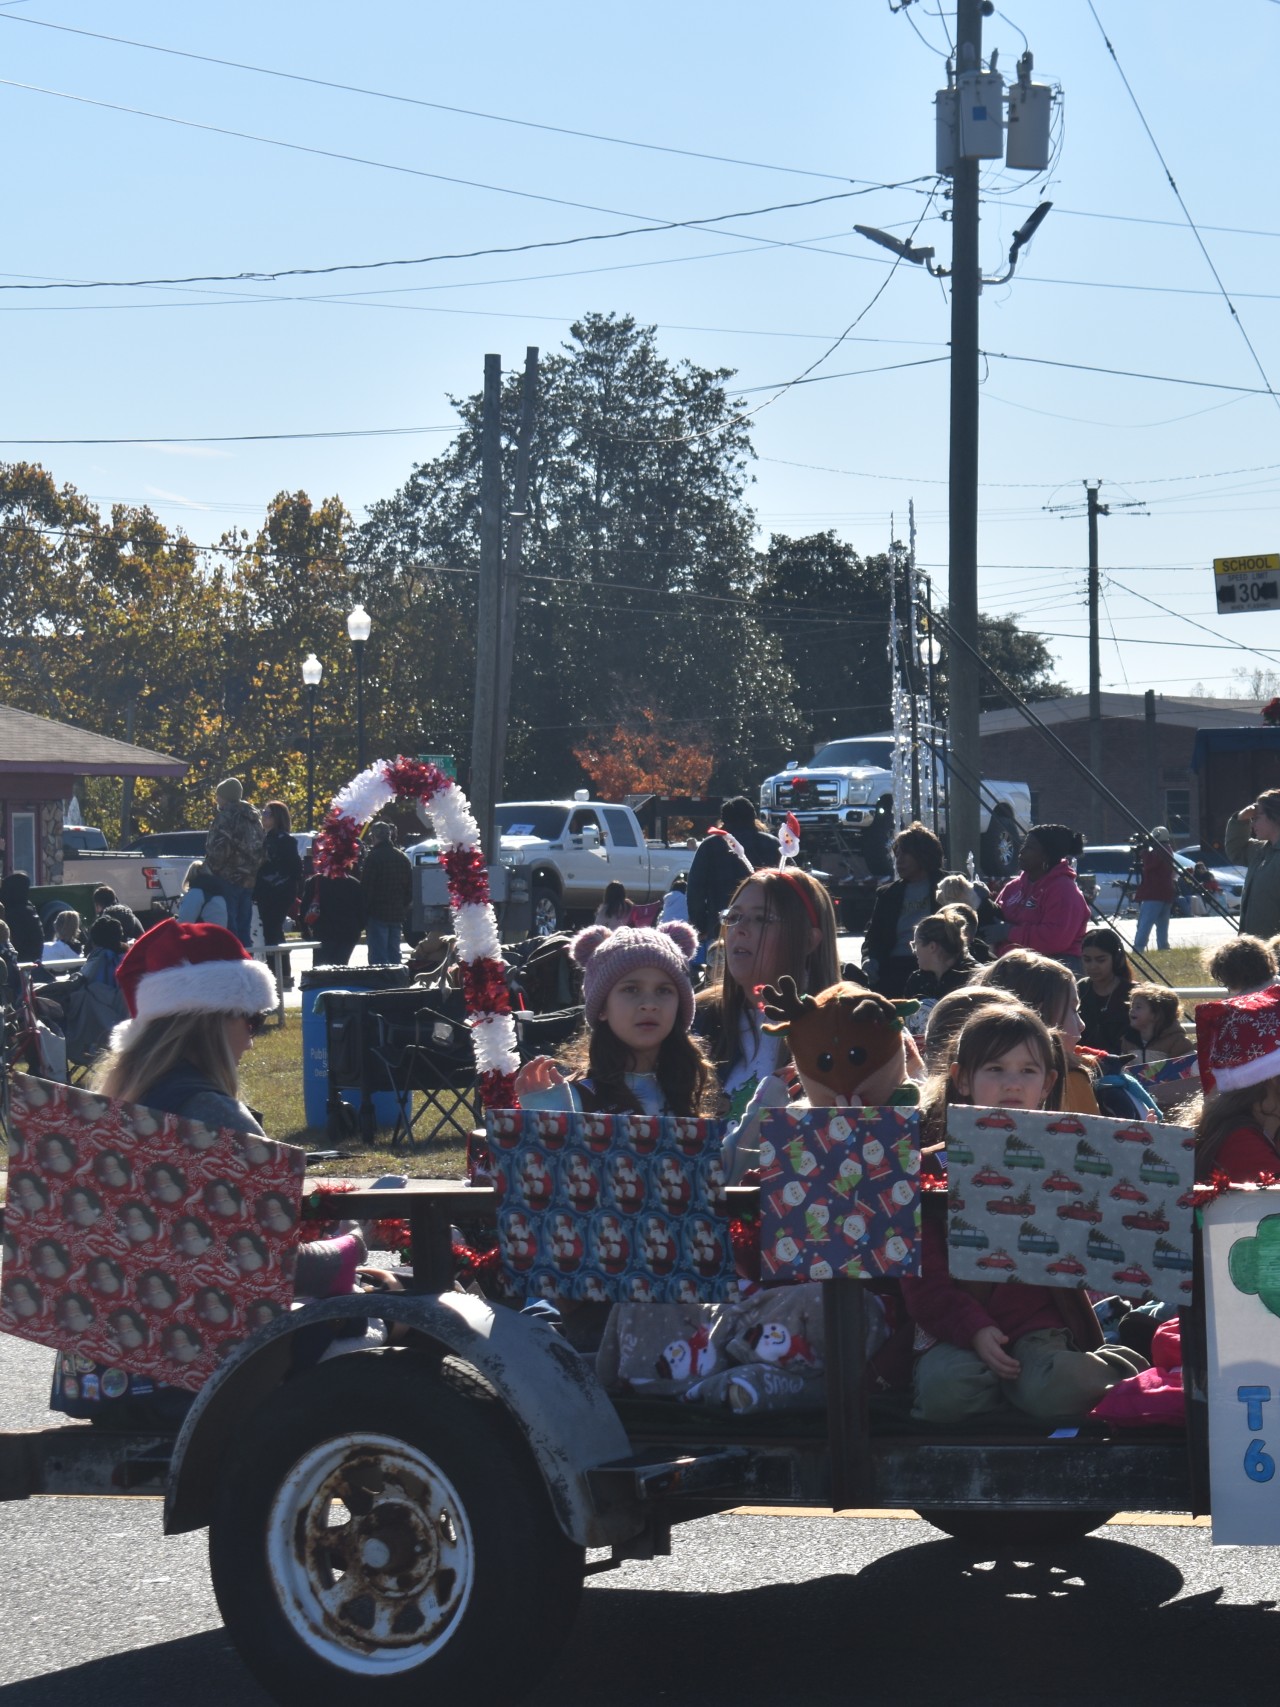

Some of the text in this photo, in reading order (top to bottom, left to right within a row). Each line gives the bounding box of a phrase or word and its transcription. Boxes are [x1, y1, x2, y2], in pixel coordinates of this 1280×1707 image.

[1222, 557, 1272, 573] SCHOOL
[1227, 571, 1268, 582] SPEED LIMIT
[1239, 582, 1260, 603] 30
